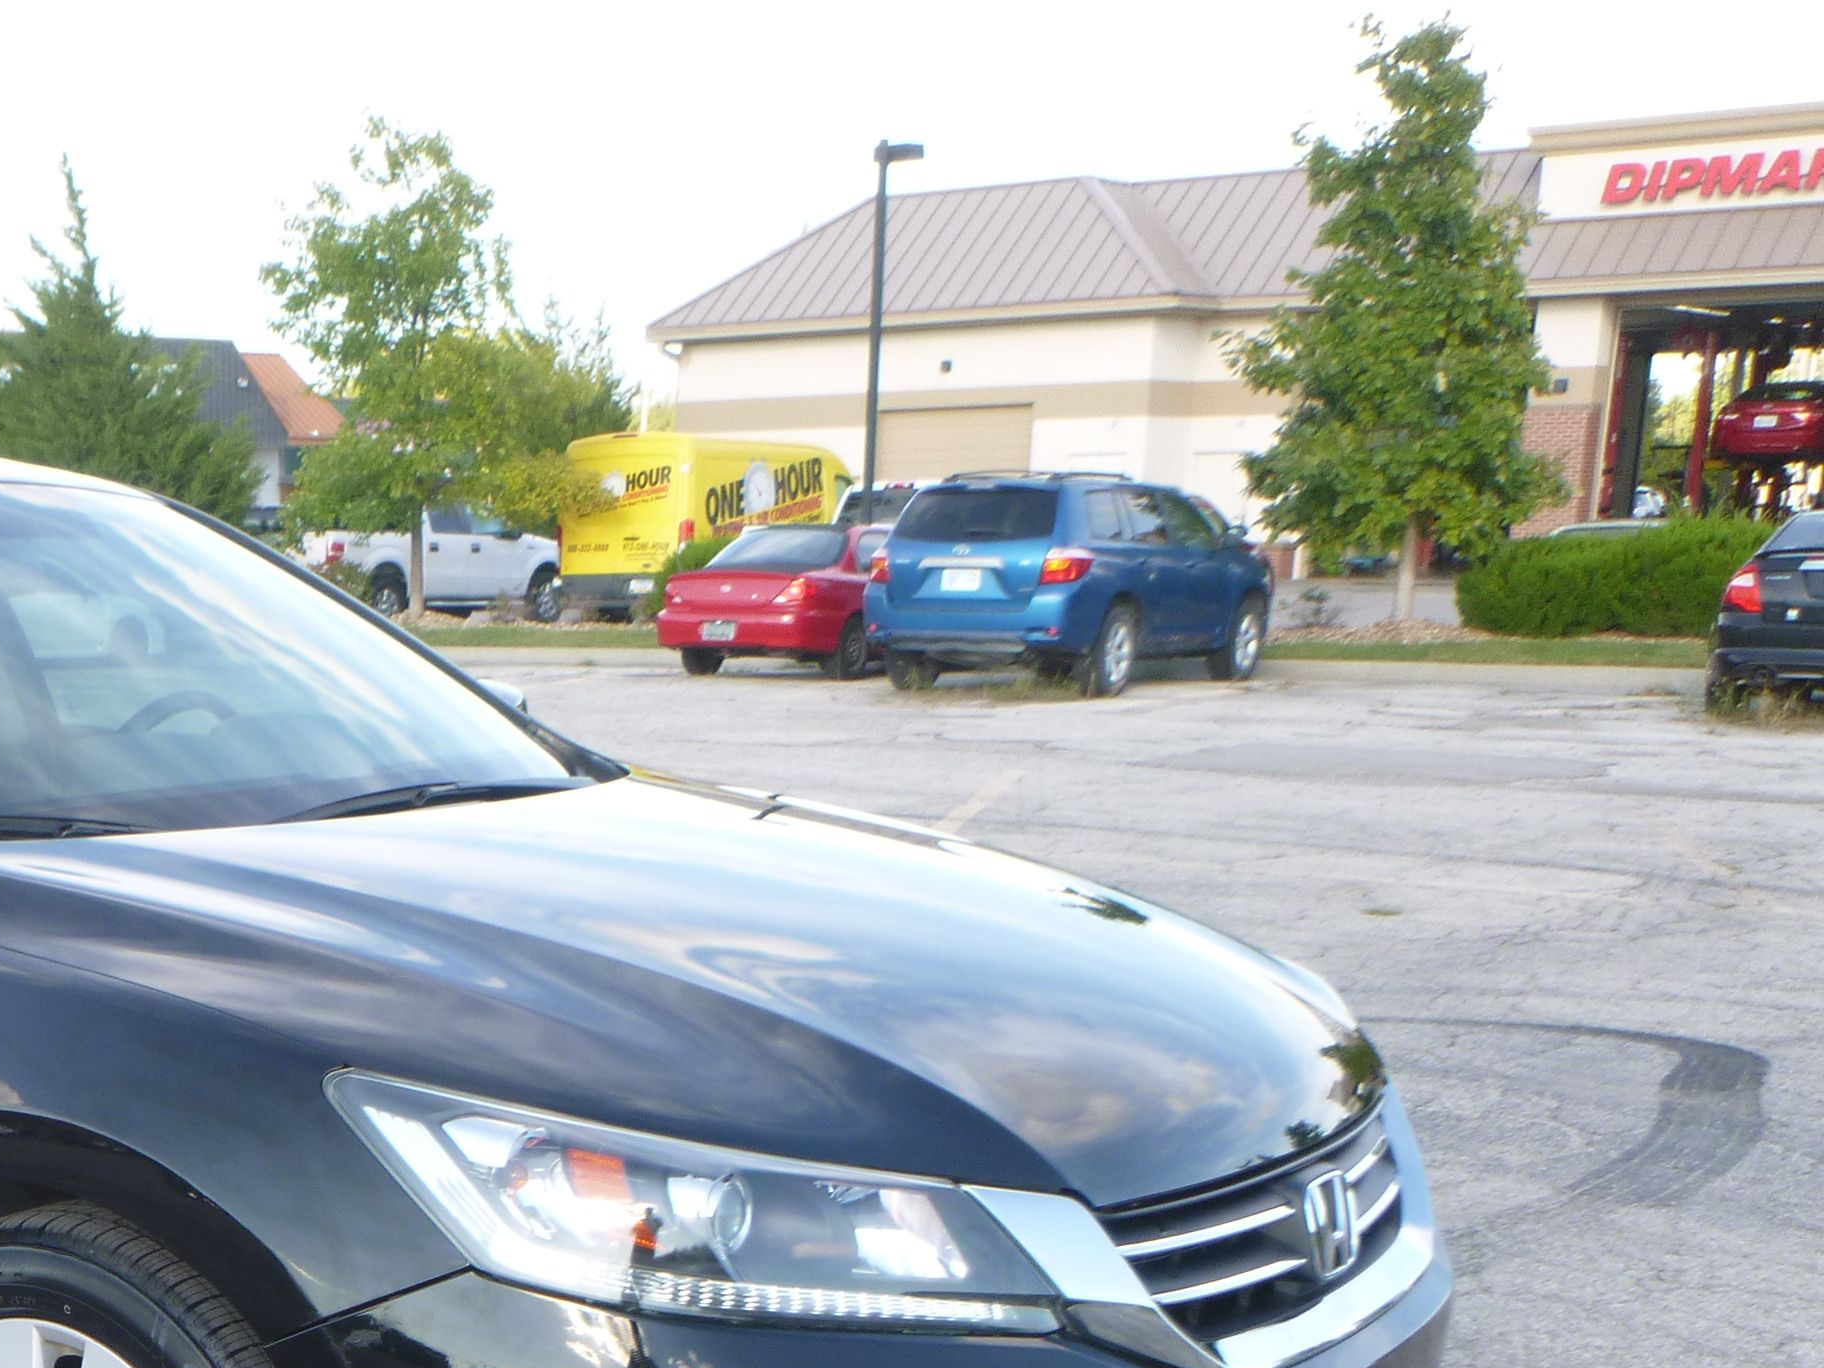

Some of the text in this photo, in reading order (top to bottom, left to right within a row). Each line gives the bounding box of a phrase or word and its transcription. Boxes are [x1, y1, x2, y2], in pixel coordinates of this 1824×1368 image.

[625, 466, 672, 493] HOUR
[706, 476, 745, 526] ONE
[773, 457, 823, 506] HOUR
